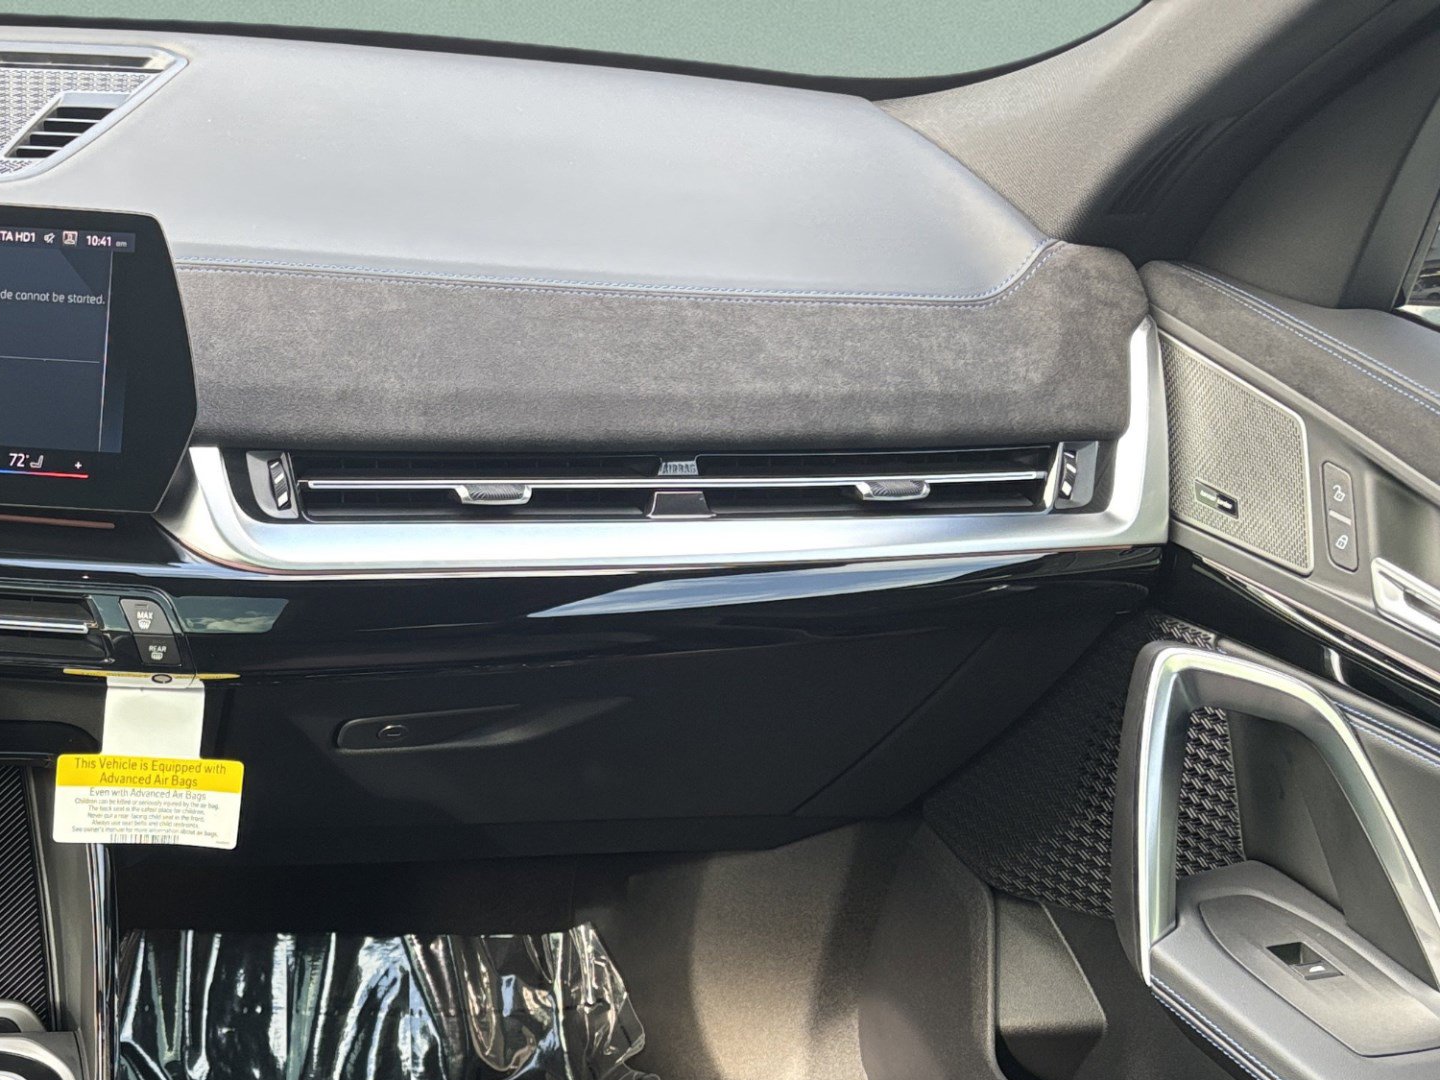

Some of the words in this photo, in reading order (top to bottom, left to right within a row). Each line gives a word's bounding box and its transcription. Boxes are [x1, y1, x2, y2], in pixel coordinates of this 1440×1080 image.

[15, 231, 36, 243] HD1
[86, 235, 112, 247] 10:41
[15, 291, 50, 302] cannot
[52, 292, 65, 302] be
[67, 293, 106, 305] started.
[137, 611, 154, 620] MAX
[148, 645, 167, 653] REAR
[75, 757, 97, 770] This
[99, 758, 137, 772] Vehicle
[140, 760, 149, 772] is
[151, 762, 202, 777] Equipped
[204, 764, 227, 775] with
[99, 772, 152, 786] Advanced
[154, 775, 169, 786] Air
[171, 775, 198, 789] Bags
[89, 788, 109, 797] Even
[111, 788, 129, 798] with
[130, 789, 170, 799] Advanced
[172, 790, 184, 799] Air
[186, 791, 207, 802] Bags
